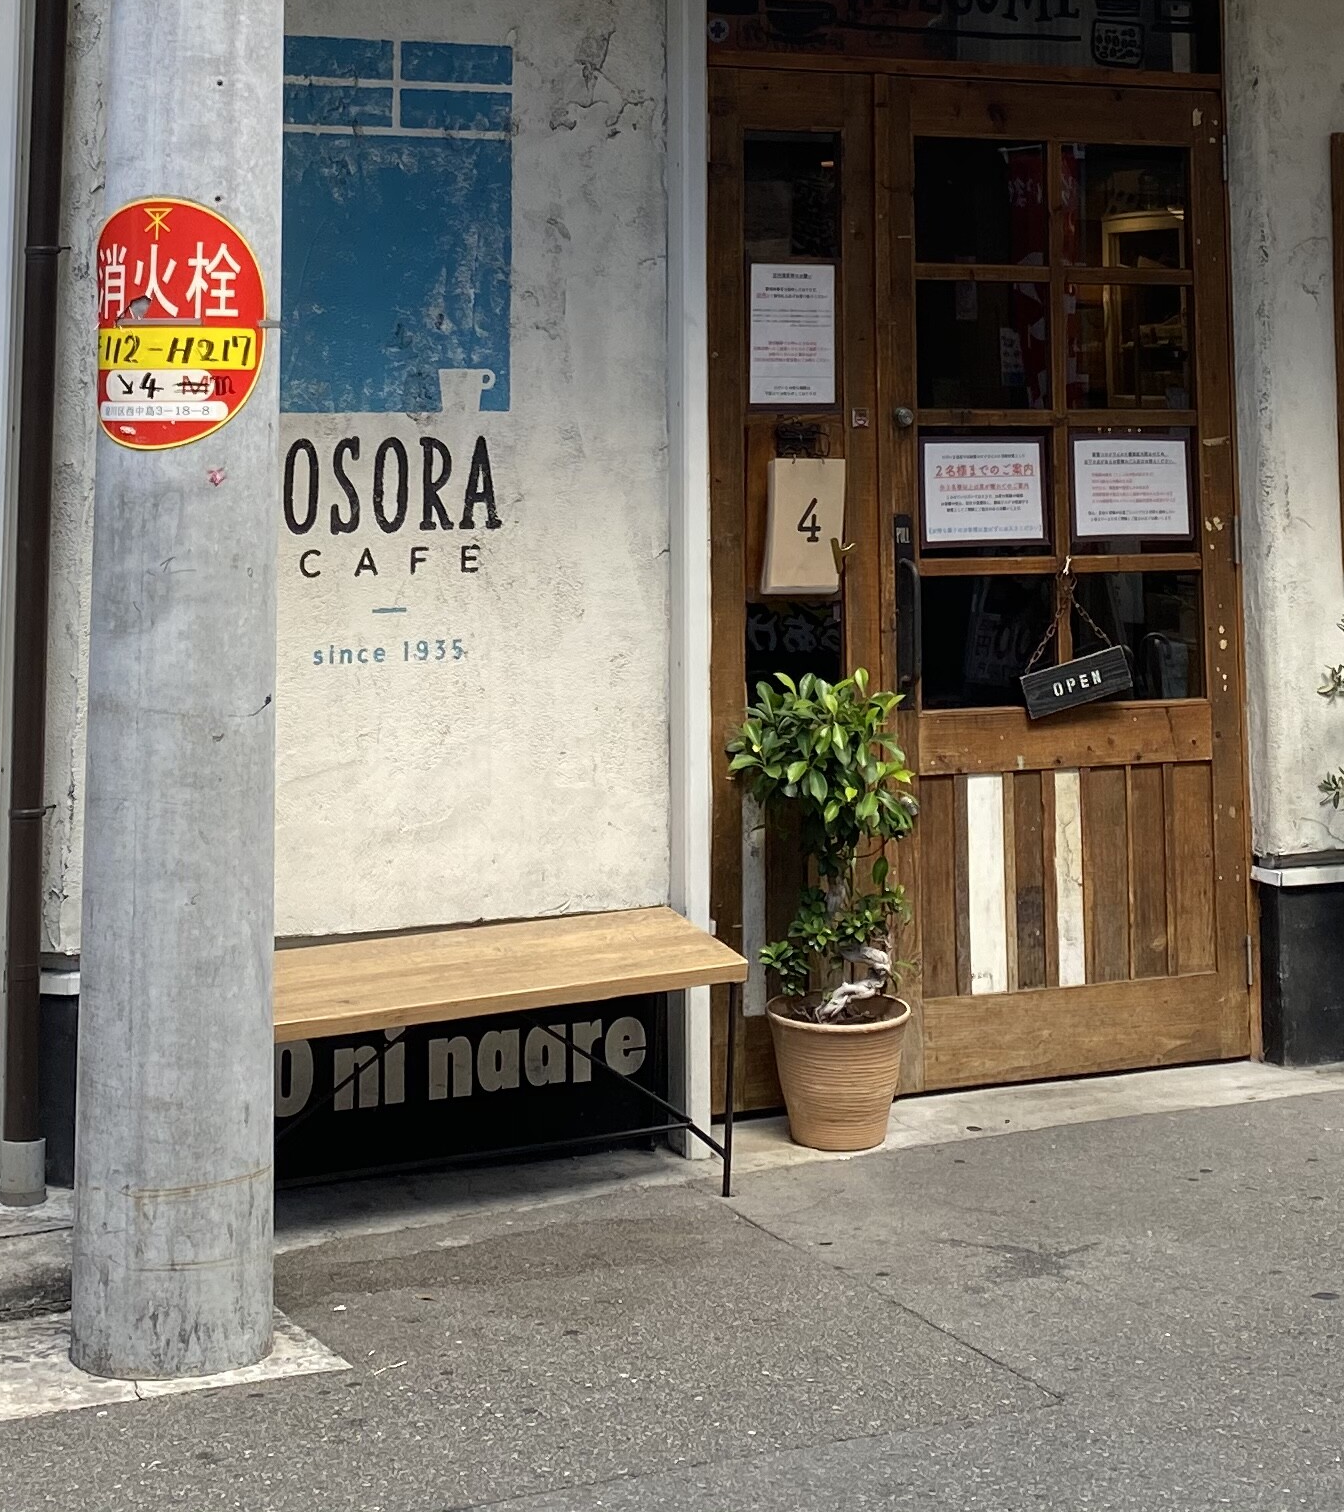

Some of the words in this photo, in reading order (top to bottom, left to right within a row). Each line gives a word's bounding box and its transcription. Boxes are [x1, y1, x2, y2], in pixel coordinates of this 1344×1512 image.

[99, 242, 242, 319] 消火栓
[283, 435, 503, 535] OSORA
[797, 498, 821, 542] 4
[299, 544, 481, 578] CAFE
[313, 645, 386, 666] since
[403, 639, 465, 661] 1935
[1052, 669, 1102, 697] OPEN
[333, 1026, 406, 1112] ni
[428, 1016, 647, 1101] naare
